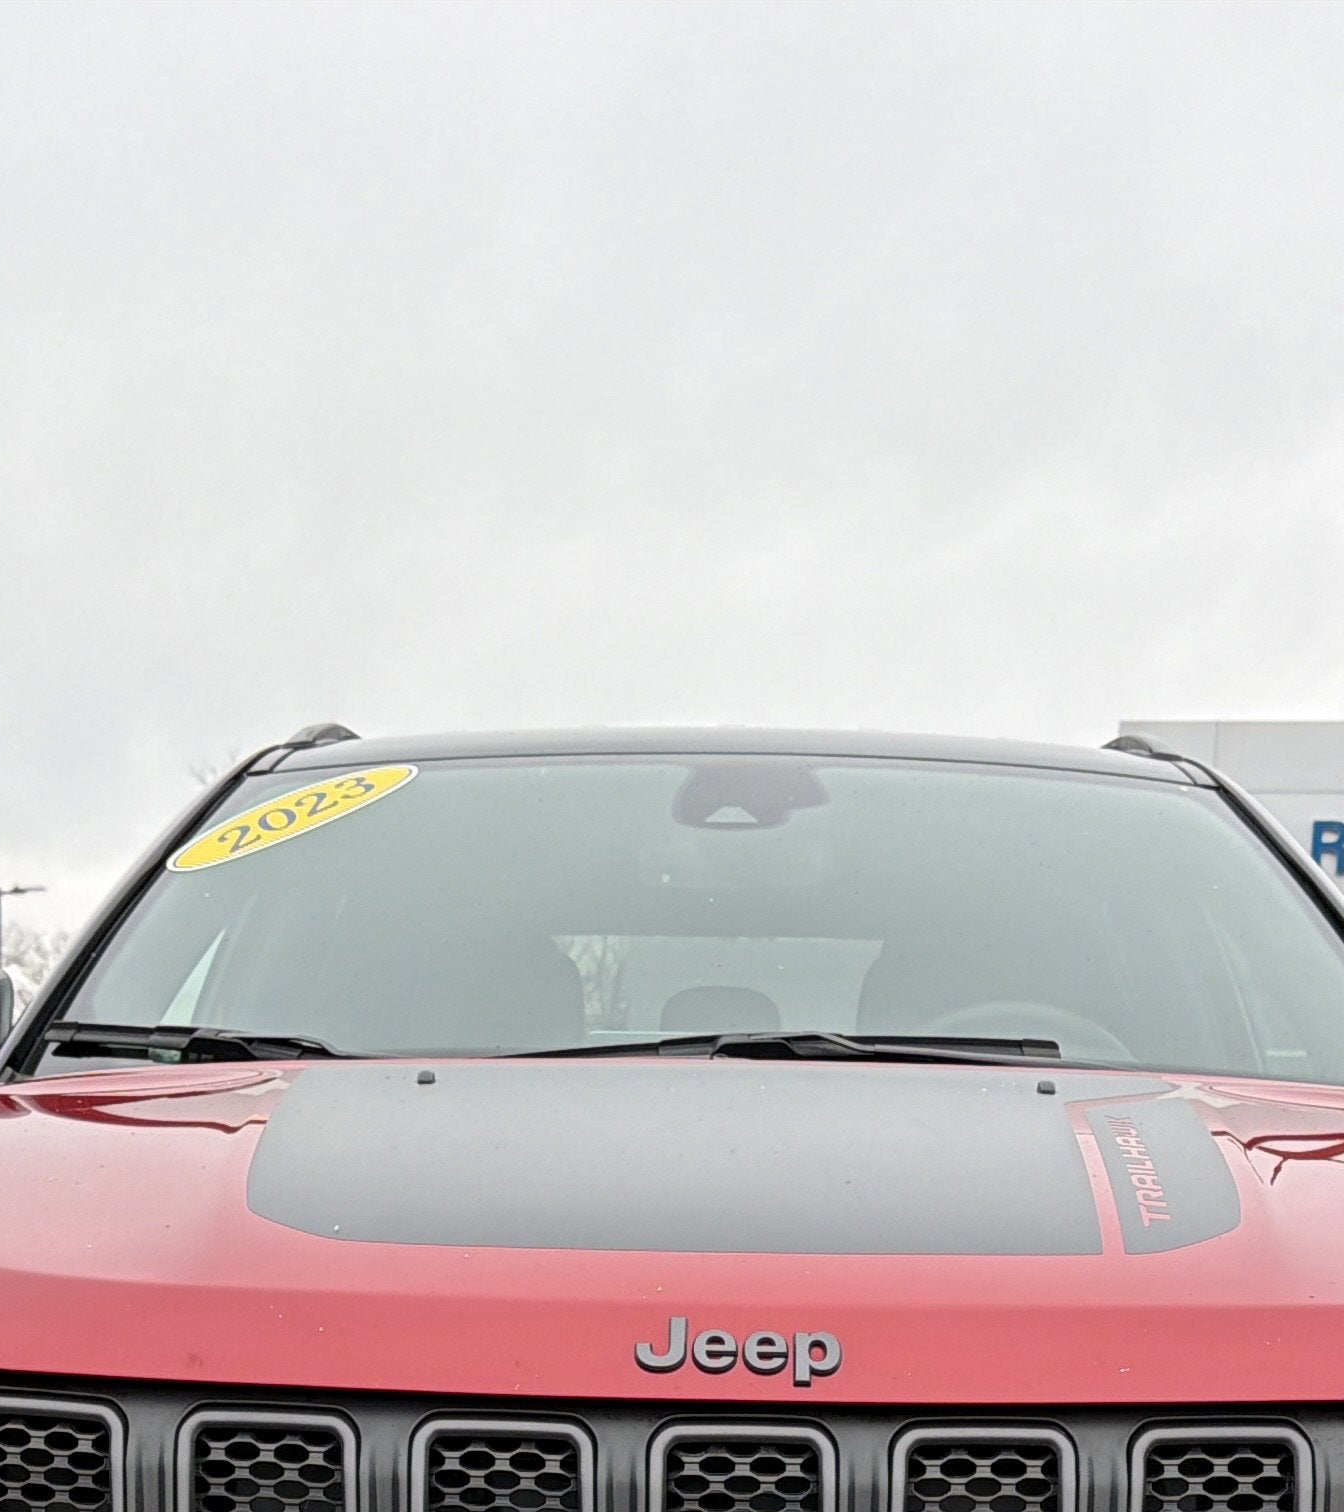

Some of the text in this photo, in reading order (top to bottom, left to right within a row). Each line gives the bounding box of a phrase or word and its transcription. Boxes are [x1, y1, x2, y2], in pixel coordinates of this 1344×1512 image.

[217, 776, 375, 853] 2023
[1104, 1114, 1172, 1227] TRAILHAWK
[634, 1315, 843, 1388] Jeep
